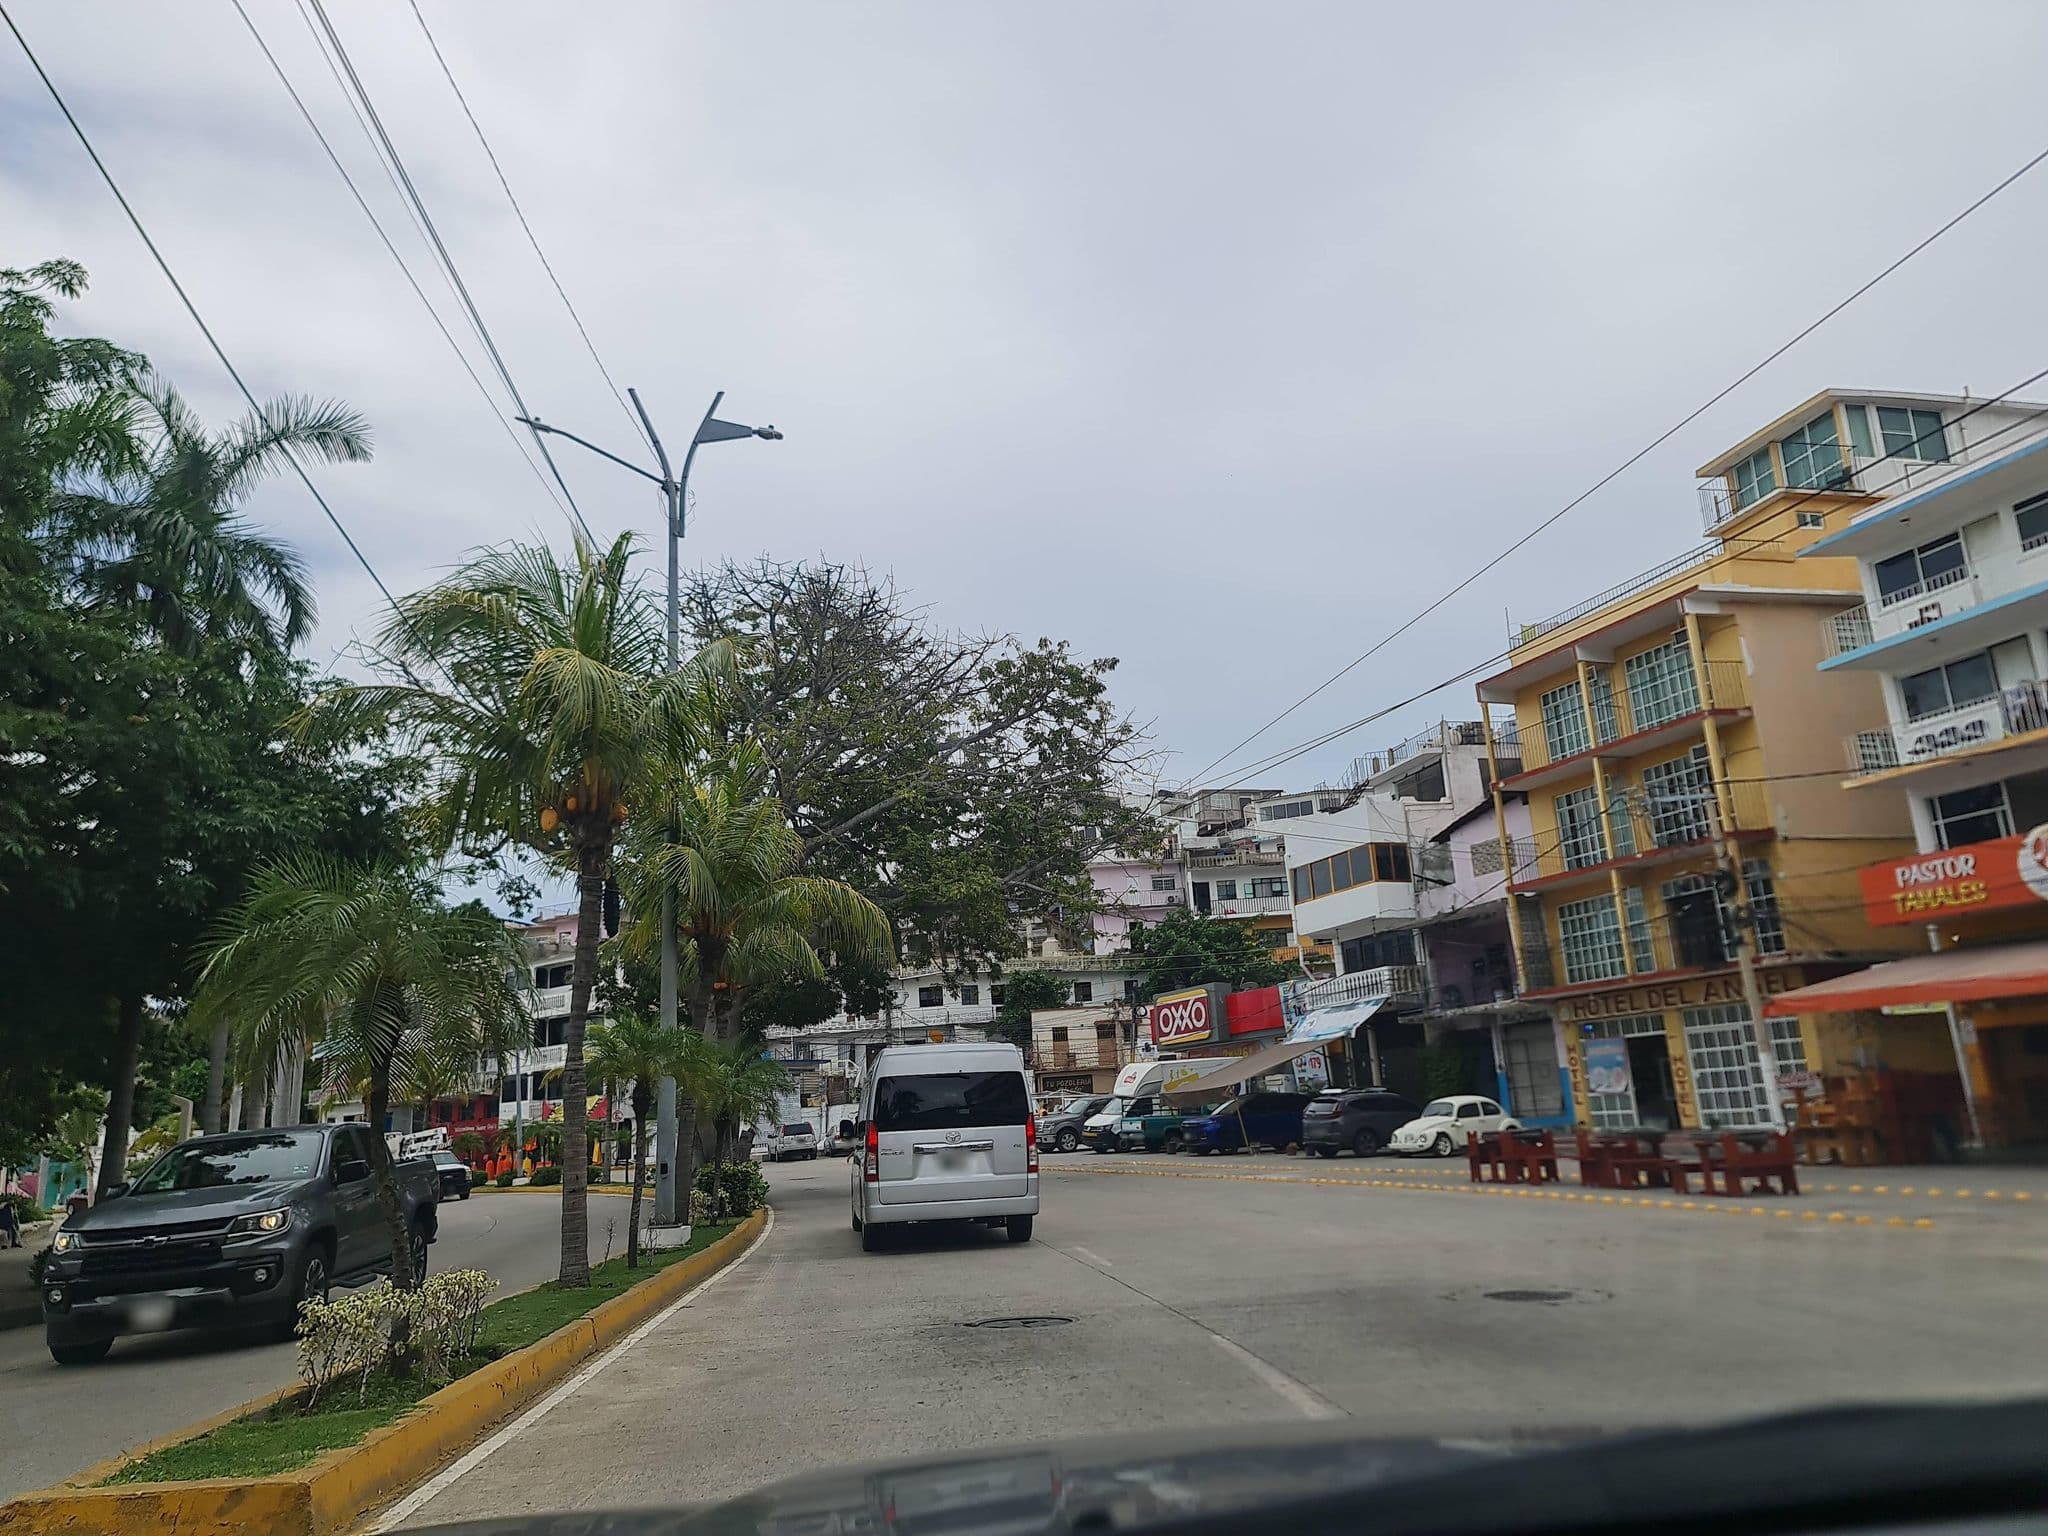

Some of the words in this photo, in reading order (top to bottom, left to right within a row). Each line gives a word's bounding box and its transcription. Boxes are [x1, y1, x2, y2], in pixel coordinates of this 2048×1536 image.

[1895, 853, 1977, 888] PASTOR
[1892, 880, 1988, 914] TAMALES
[1574, 993, 1643, 1018] HOTEL
[1646, 986, 1694, 1009] DEL
[1704, 972, 1792, 1003] ANEL
[1159, 998, 1206, 1038] OXXO
[1567, 1044, 1585, 1105] HOTEL
[1673, 1056, 1692, 1118] HOTEL
